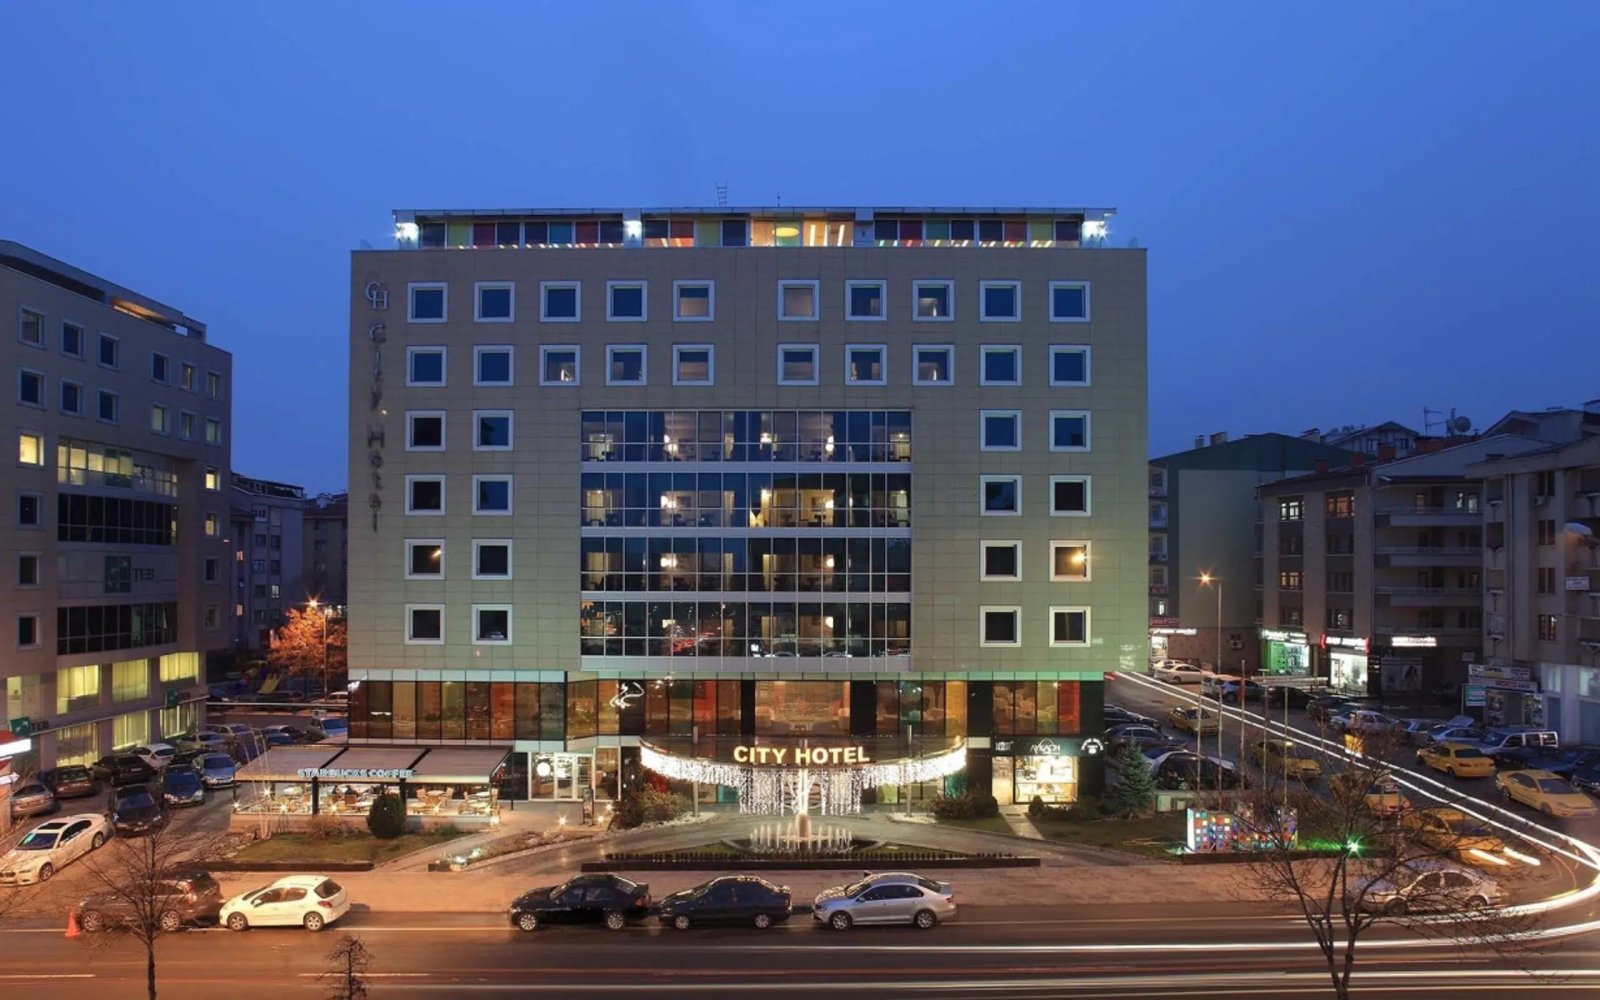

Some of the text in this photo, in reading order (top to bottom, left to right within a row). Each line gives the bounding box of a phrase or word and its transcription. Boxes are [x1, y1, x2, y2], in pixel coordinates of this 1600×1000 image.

[133, 568, 154, 580] TEB
[733, 745, 871, 764] CITY HOTEL
[298, 768, 367, 778] STARBUCKS
